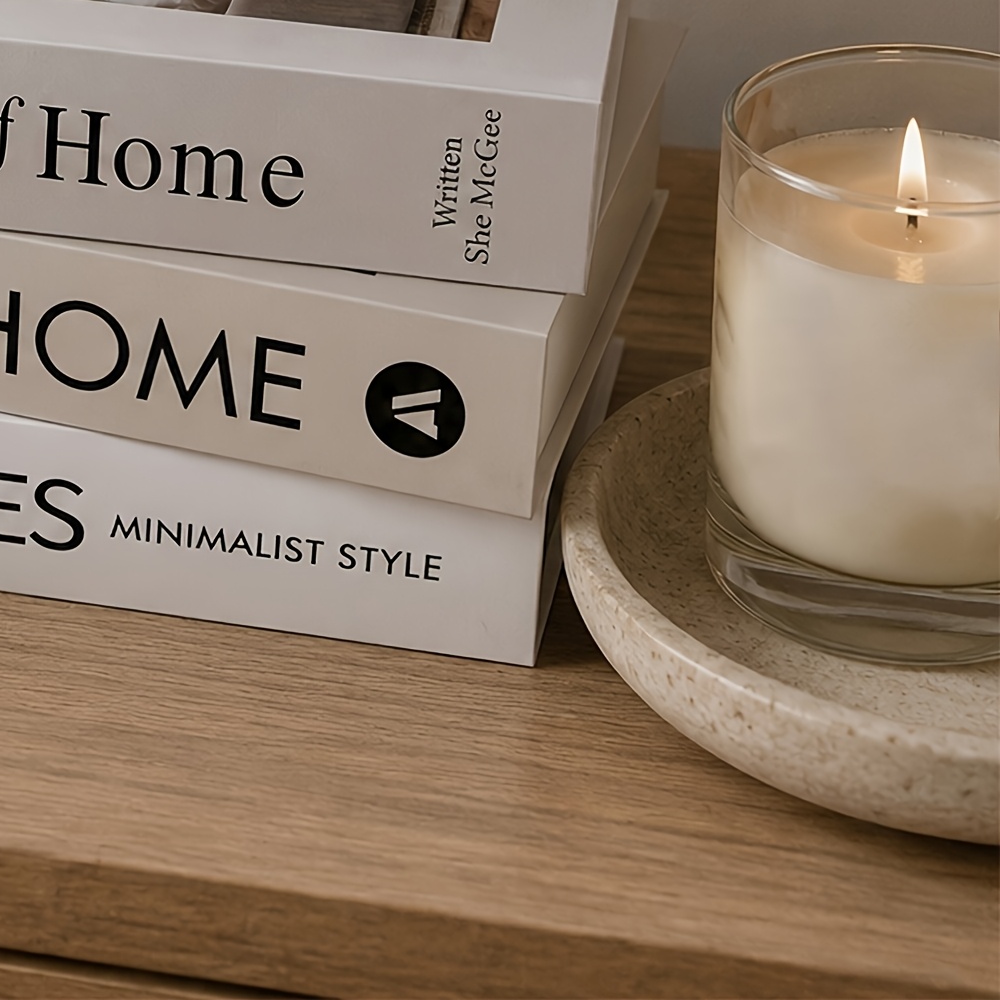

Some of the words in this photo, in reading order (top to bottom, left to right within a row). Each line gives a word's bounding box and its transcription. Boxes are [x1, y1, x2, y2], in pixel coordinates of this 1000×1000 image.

[35, 103, 306, 209] Home
[431, 136, 463, 229] Written
[469, 108, 502, 209] McGee
[464, 214, 492, 265] She
[109, 513, 325, 566] MINIMALIST
[336, 542, 444, 583] STYLE
